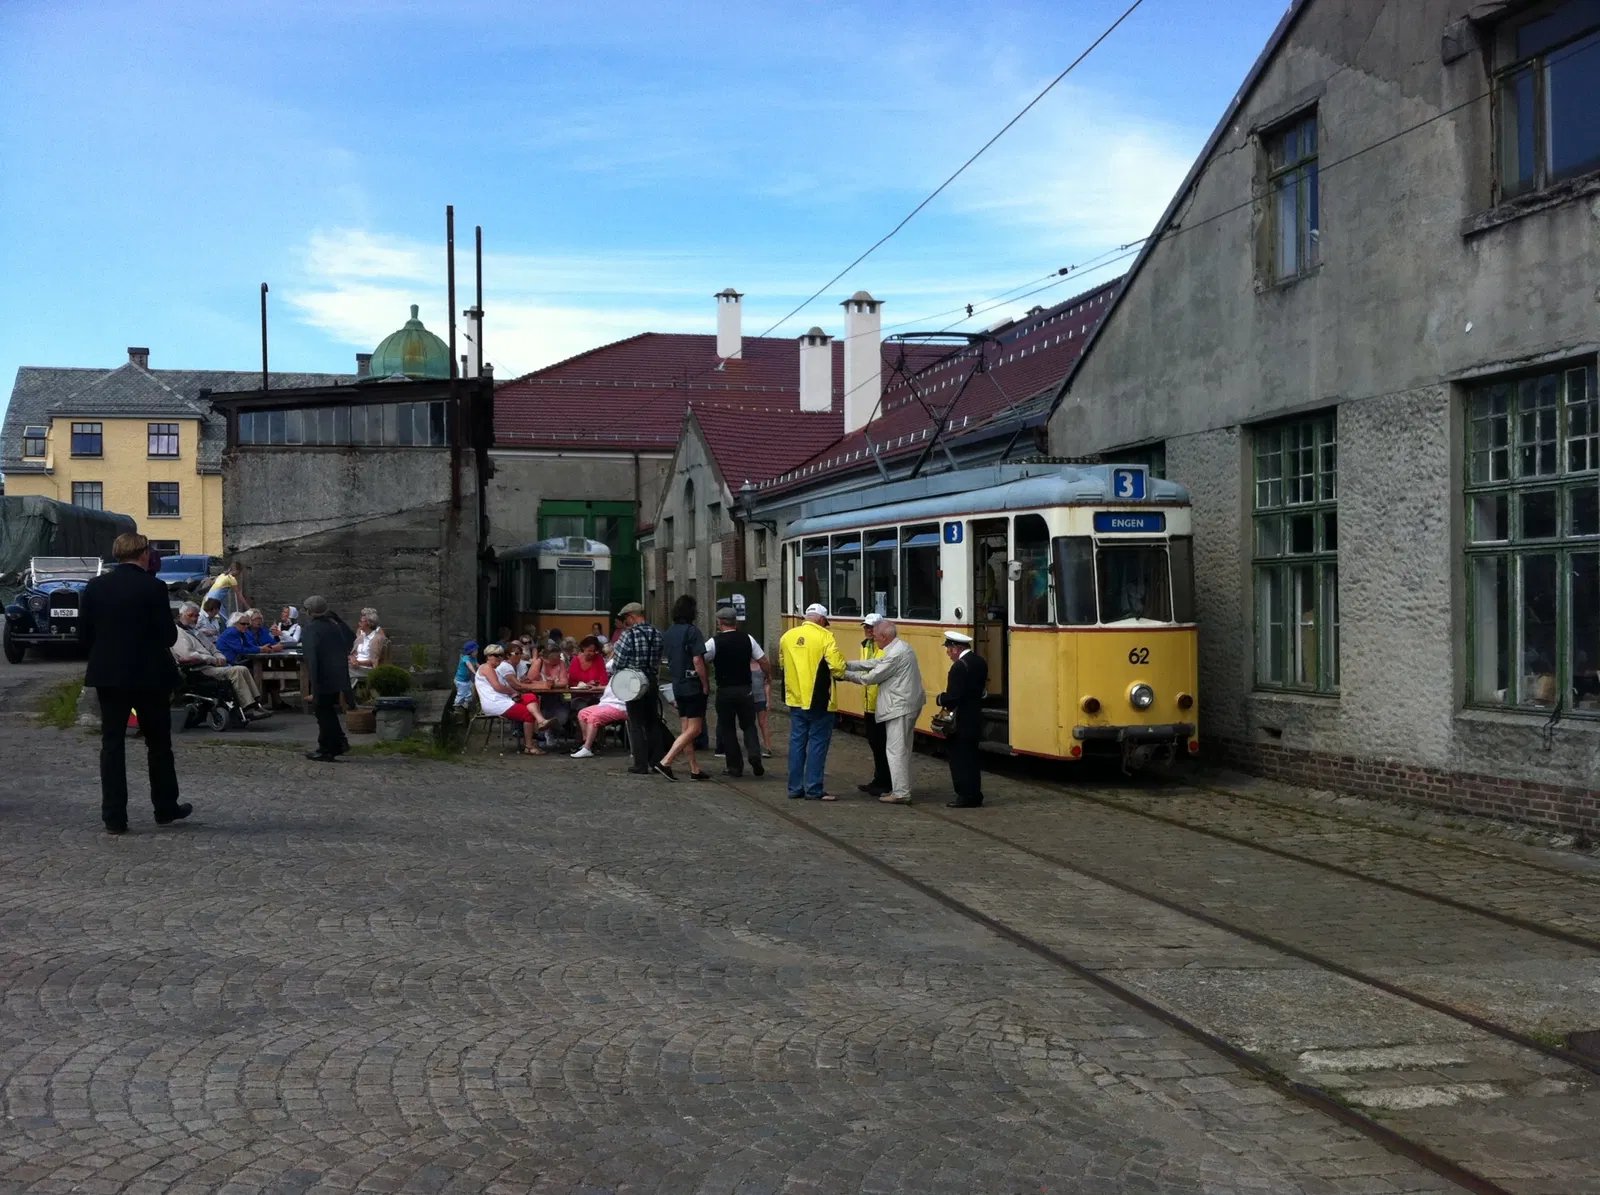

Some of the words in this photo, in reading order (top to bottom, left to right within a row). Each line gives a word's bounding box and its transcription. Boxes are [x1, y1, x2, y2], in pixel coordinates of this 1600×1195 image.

[1118, 471, 1134, 497] 3
[1111, 519, 1144, 528] ENGEN
[952, 524, 958, 541] 3
[1128, 647, 1150, 665] 62
